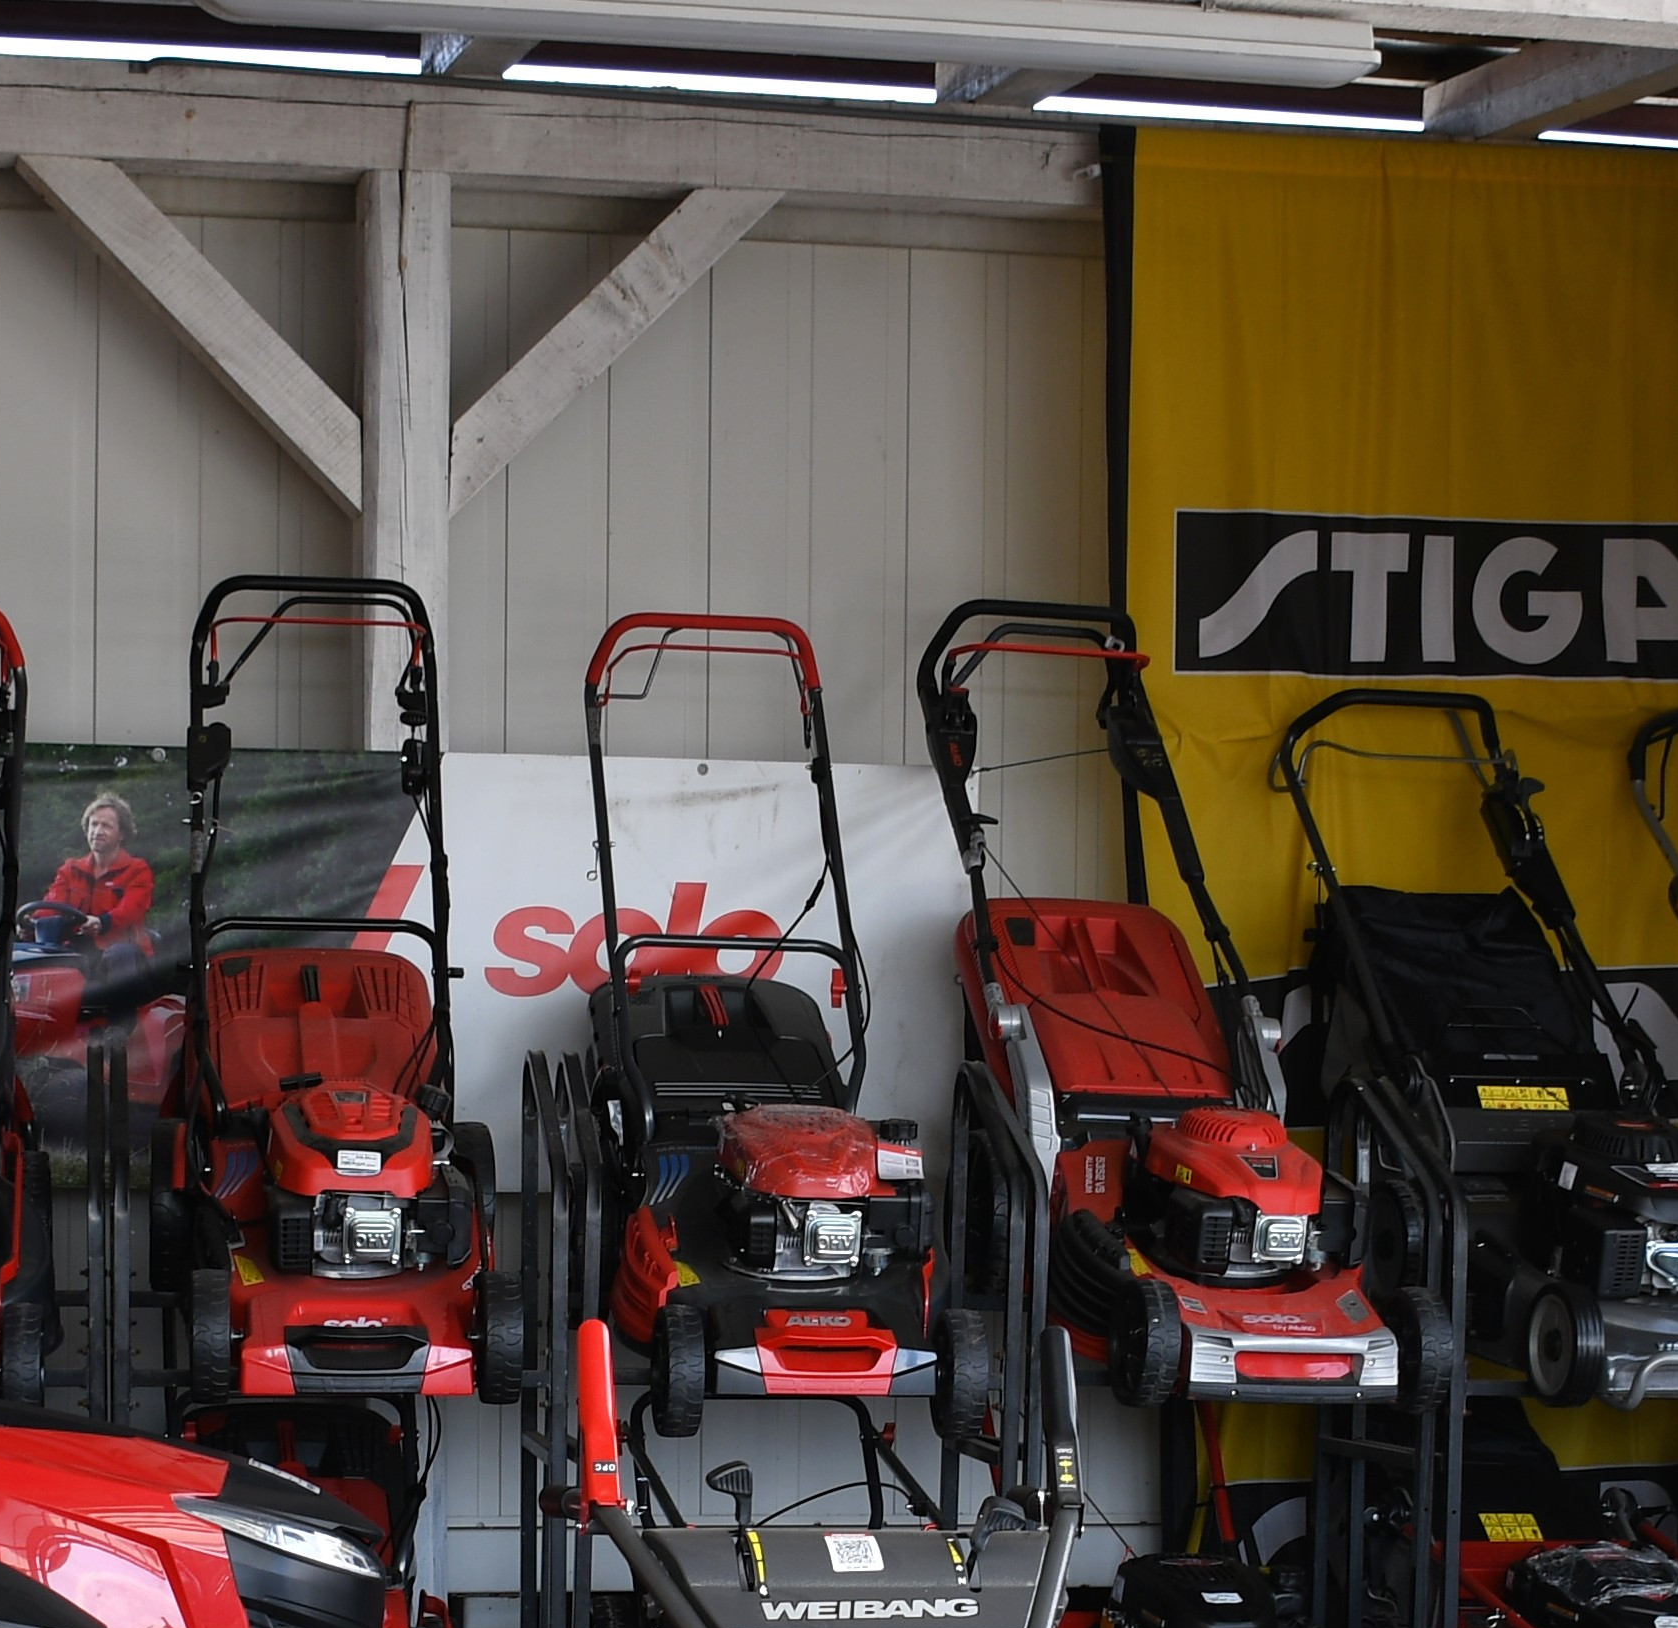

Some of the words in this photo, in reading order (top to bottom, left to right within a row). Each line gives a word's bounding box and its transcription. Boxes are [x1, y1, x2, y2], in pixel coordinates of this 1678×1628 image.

[485, 882, 785, 999] solo
[786, 1315, 853, 1329] AL-KO
[1241, 1312, 1301, 1325] solo
[760, 1597, 980, 1622] WEIBANG
